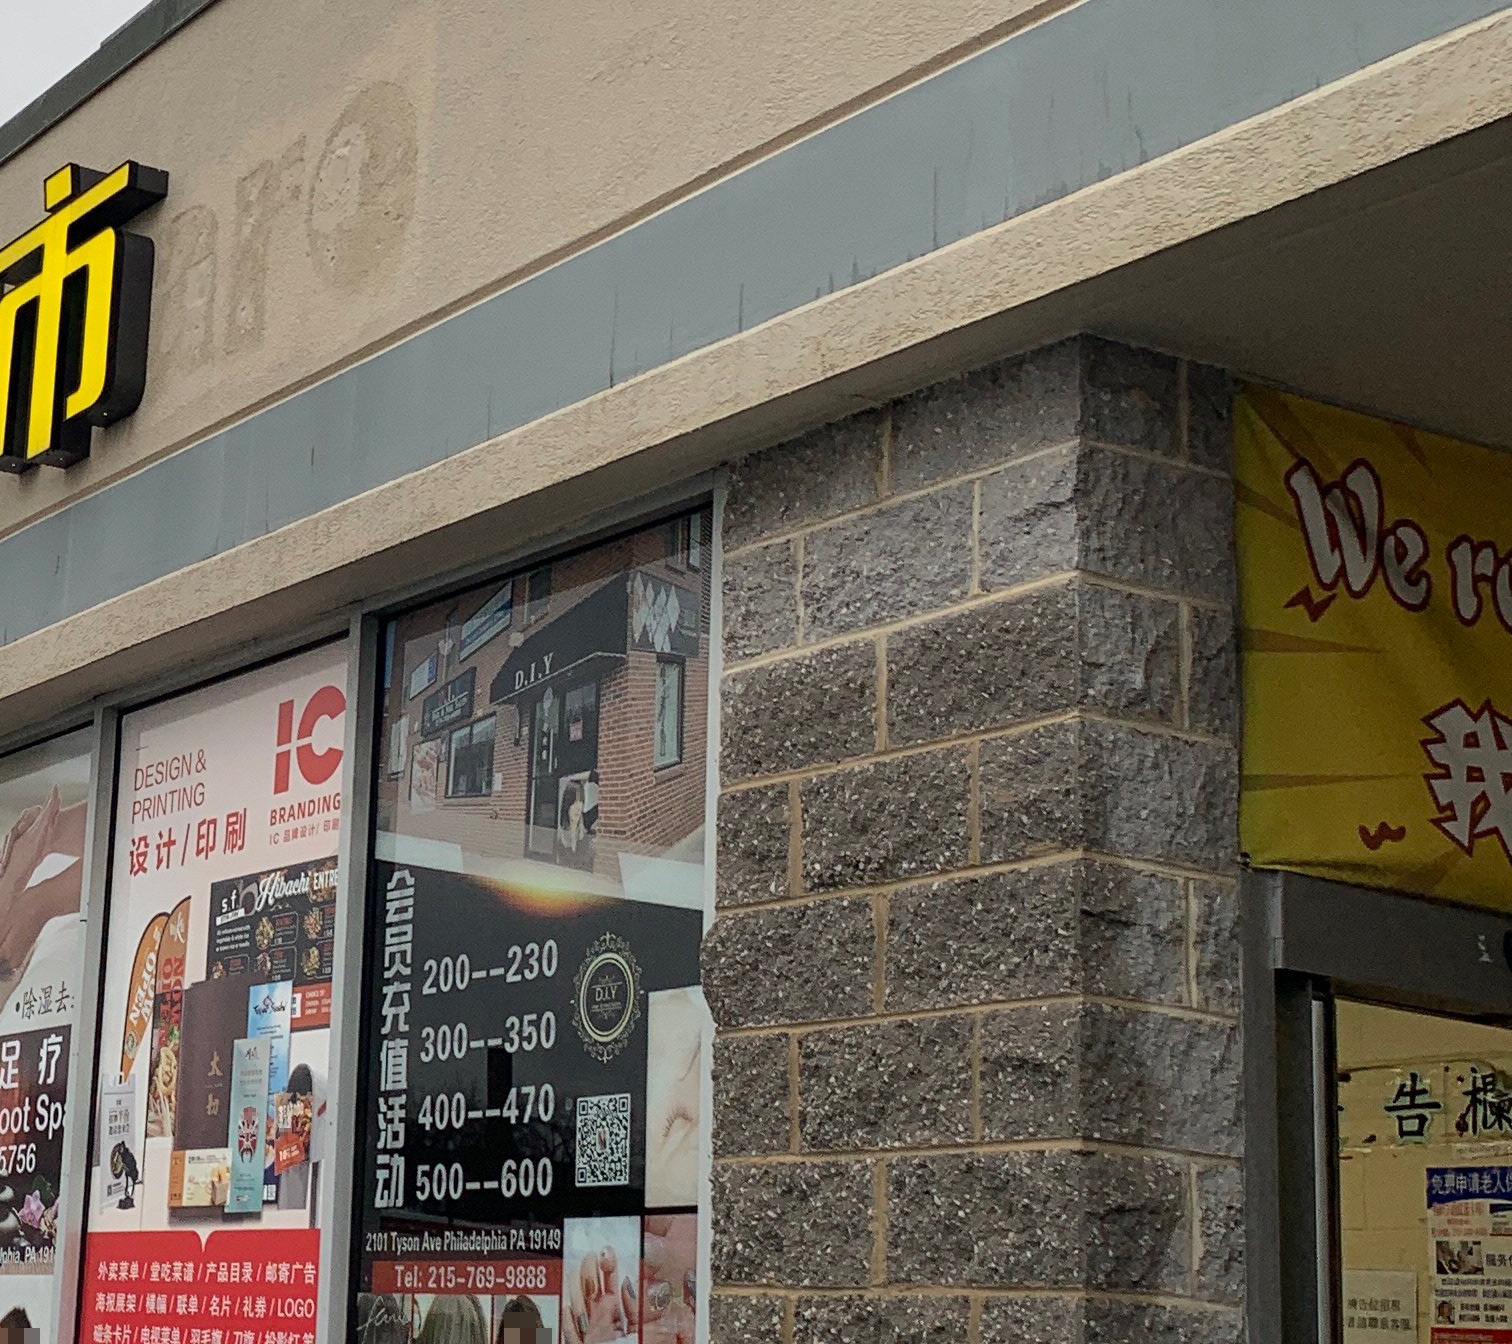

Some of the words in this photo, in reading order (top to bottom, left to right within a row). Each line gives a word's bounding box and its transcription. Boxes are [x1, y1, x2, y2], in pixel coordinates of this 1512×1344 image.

[1285, 458, 1431, 612] We
[273, 685, 346, 795] IC
[134, 753, 192, 791] DESIGN
[195, 748, 207, 772] &
[131, 782, 206, 824] PRINTING
[270, 792, 341, 826] BRANDING
[21, 980, 75, 1020] 除湿去
[375, 869, 415, 1208] 会员充值活动
[35, 1094, 66, 1141] Sp
[38, 1245, 56, 1264] 191
[365, 1232, 388, 1252] 2101
[390, 1231, 420, 1255] Tyson
[421, 1231, 441, 1252] Ave
[443, 1229, 507, 1255] Philadelphia
[509, 1229, 525, 1251] PA
[529, 1228, 561, 1250] 19149
[205, 1261, 253, 1283] 产品目录
[394, 1265, 422, 1289] Tel:
[428, 1265, 547, 1289] 215-769-9888
[209, 1294, 231, 1317] 名片
[277, 1298, 315, 1319] LOGO
